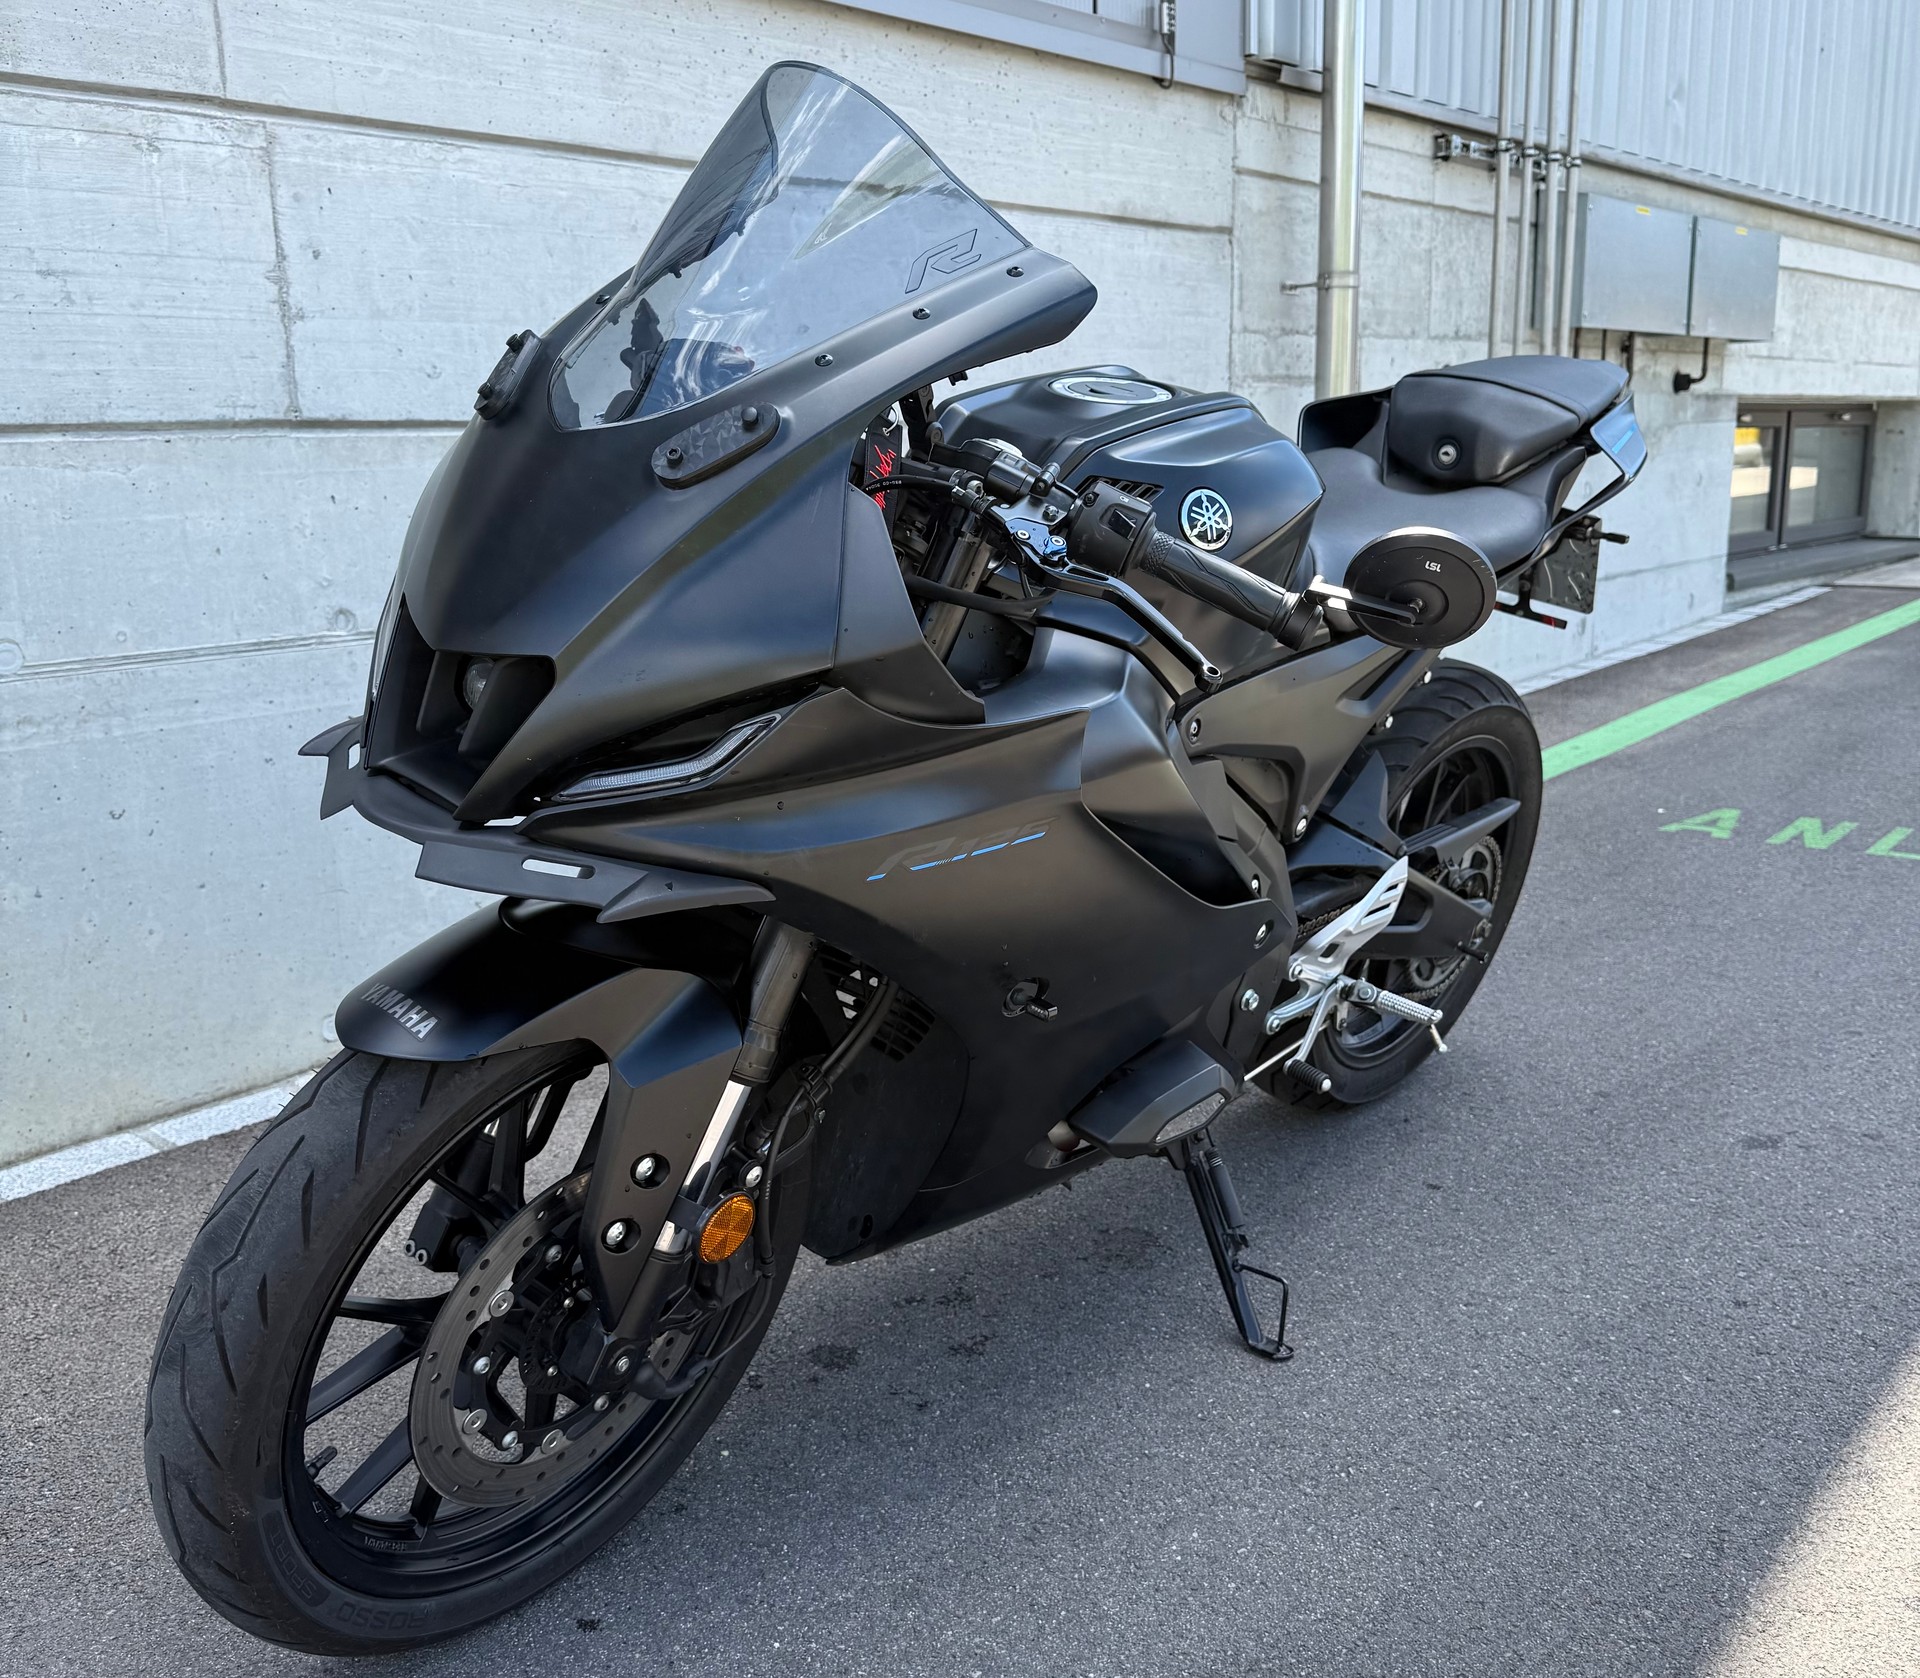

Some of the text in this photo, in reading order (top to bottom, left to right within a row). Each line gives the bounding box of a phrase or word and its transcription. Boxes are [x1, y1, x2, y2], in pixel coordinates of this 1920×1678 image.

[1657, 807, 1920, 861] ANL
[361, 982, 439, 1039] YAMAHA
[336, 1602, 427, 1631] ROSSO
